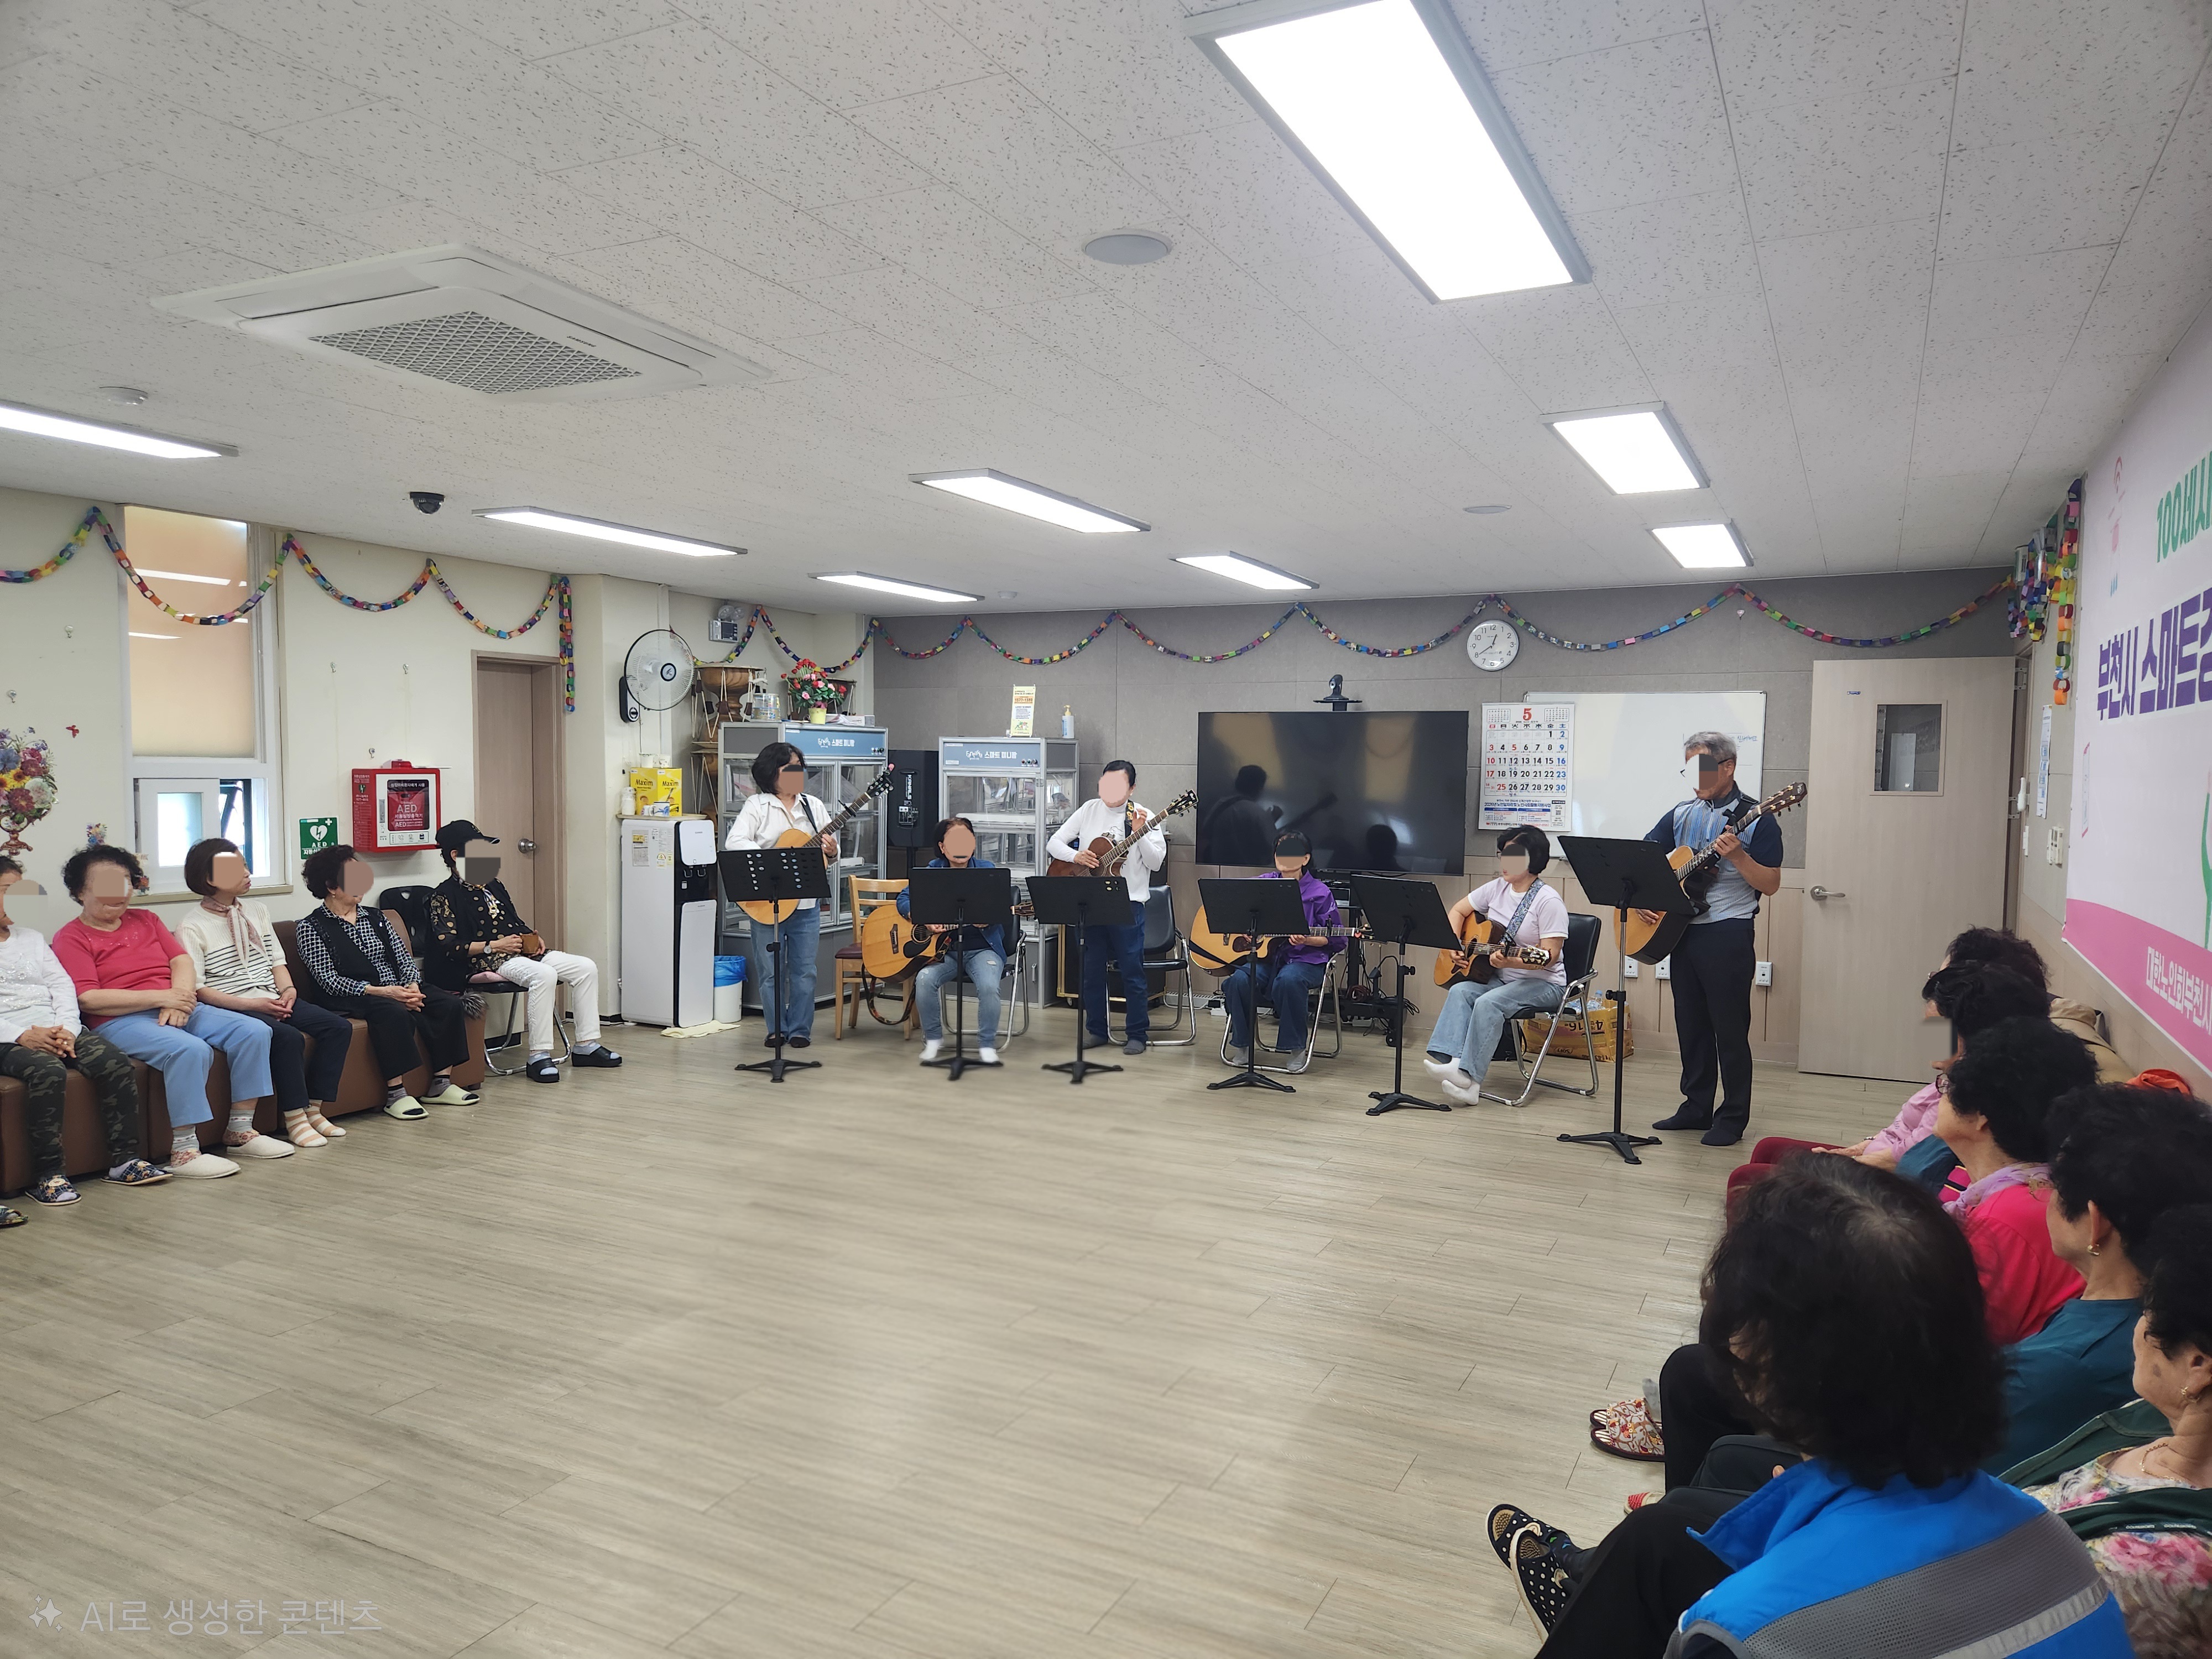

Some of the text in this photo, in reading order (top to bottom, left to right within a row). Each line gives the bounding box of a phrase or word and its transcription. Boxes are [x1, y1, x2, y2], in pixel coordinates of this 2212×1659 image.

[2097, 626, 2138, 721] 부천시
[1523, 708, 1532, 721] 5
[397, 805, 417, 813] AED
